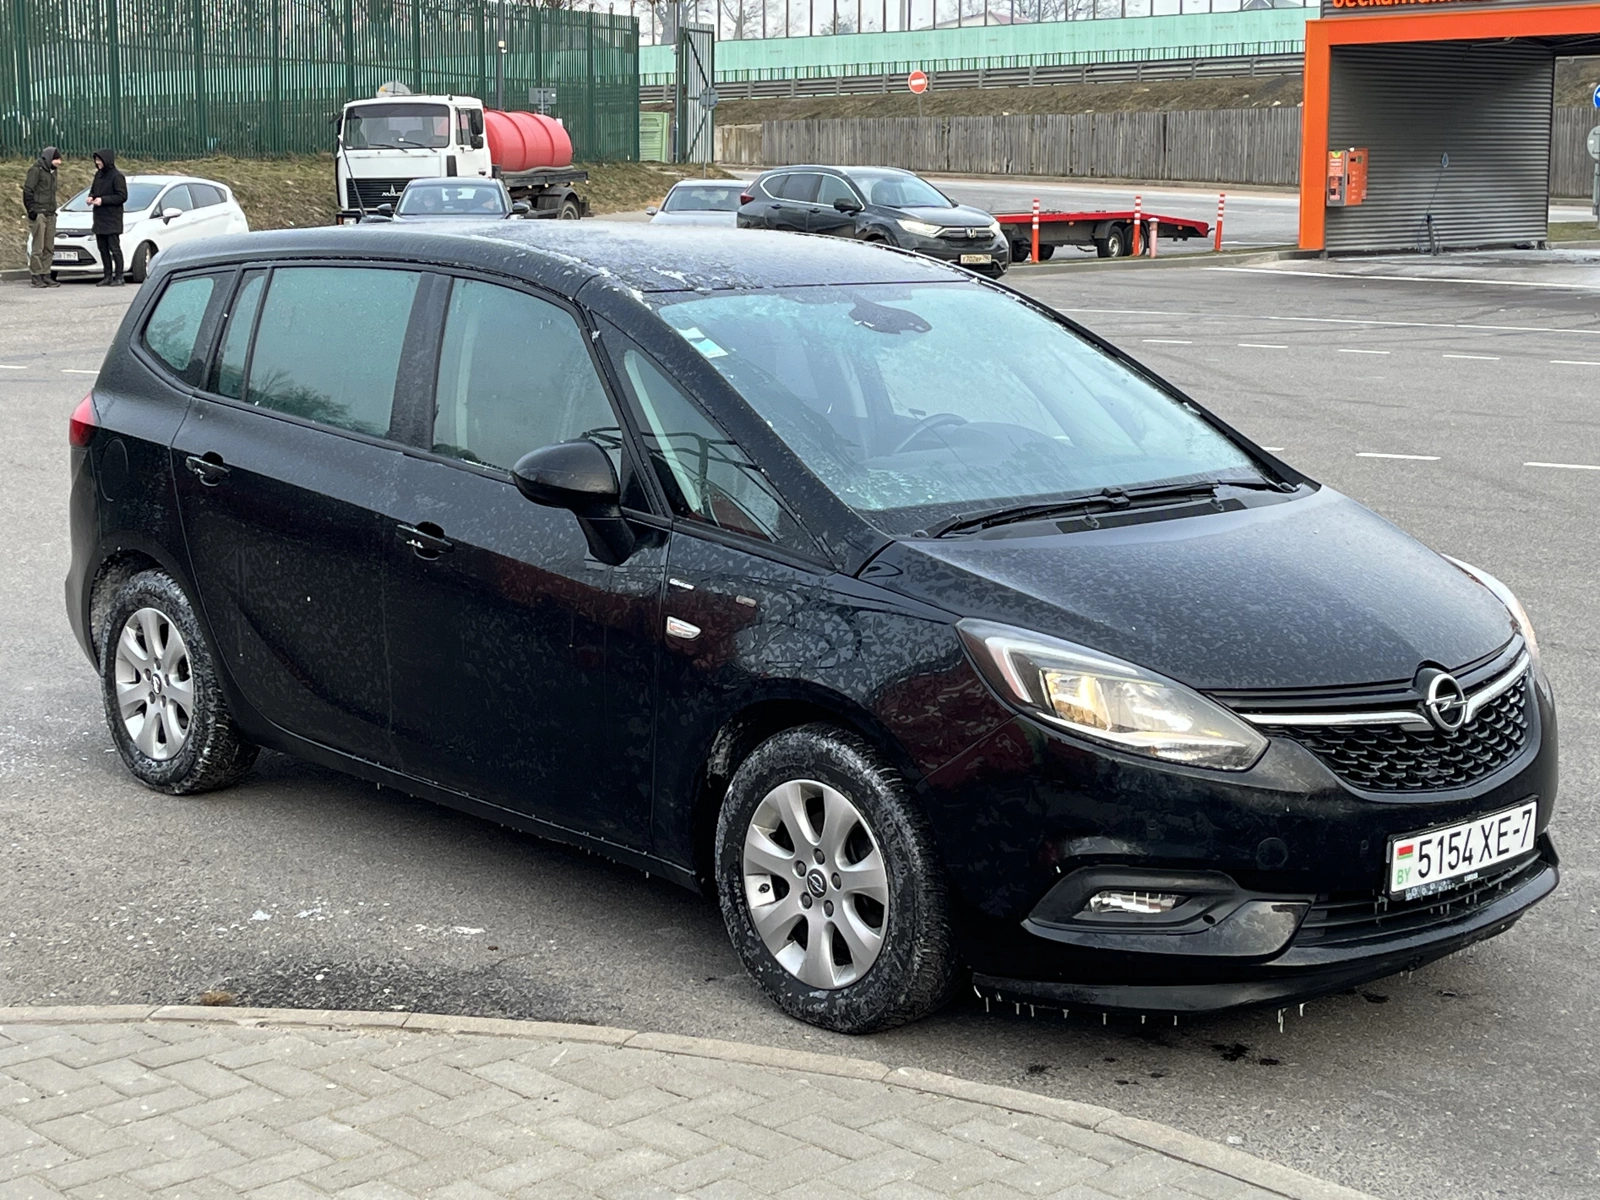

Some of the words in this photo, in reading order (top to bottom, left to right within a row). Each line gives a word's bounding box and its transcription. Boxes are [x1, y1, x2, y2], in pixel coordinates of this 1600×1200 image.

[1418, 828, 1473, 878] 5154
[1479, 809, 1532, 863] XE-7
[1397, 867, 1411, 885] BY
